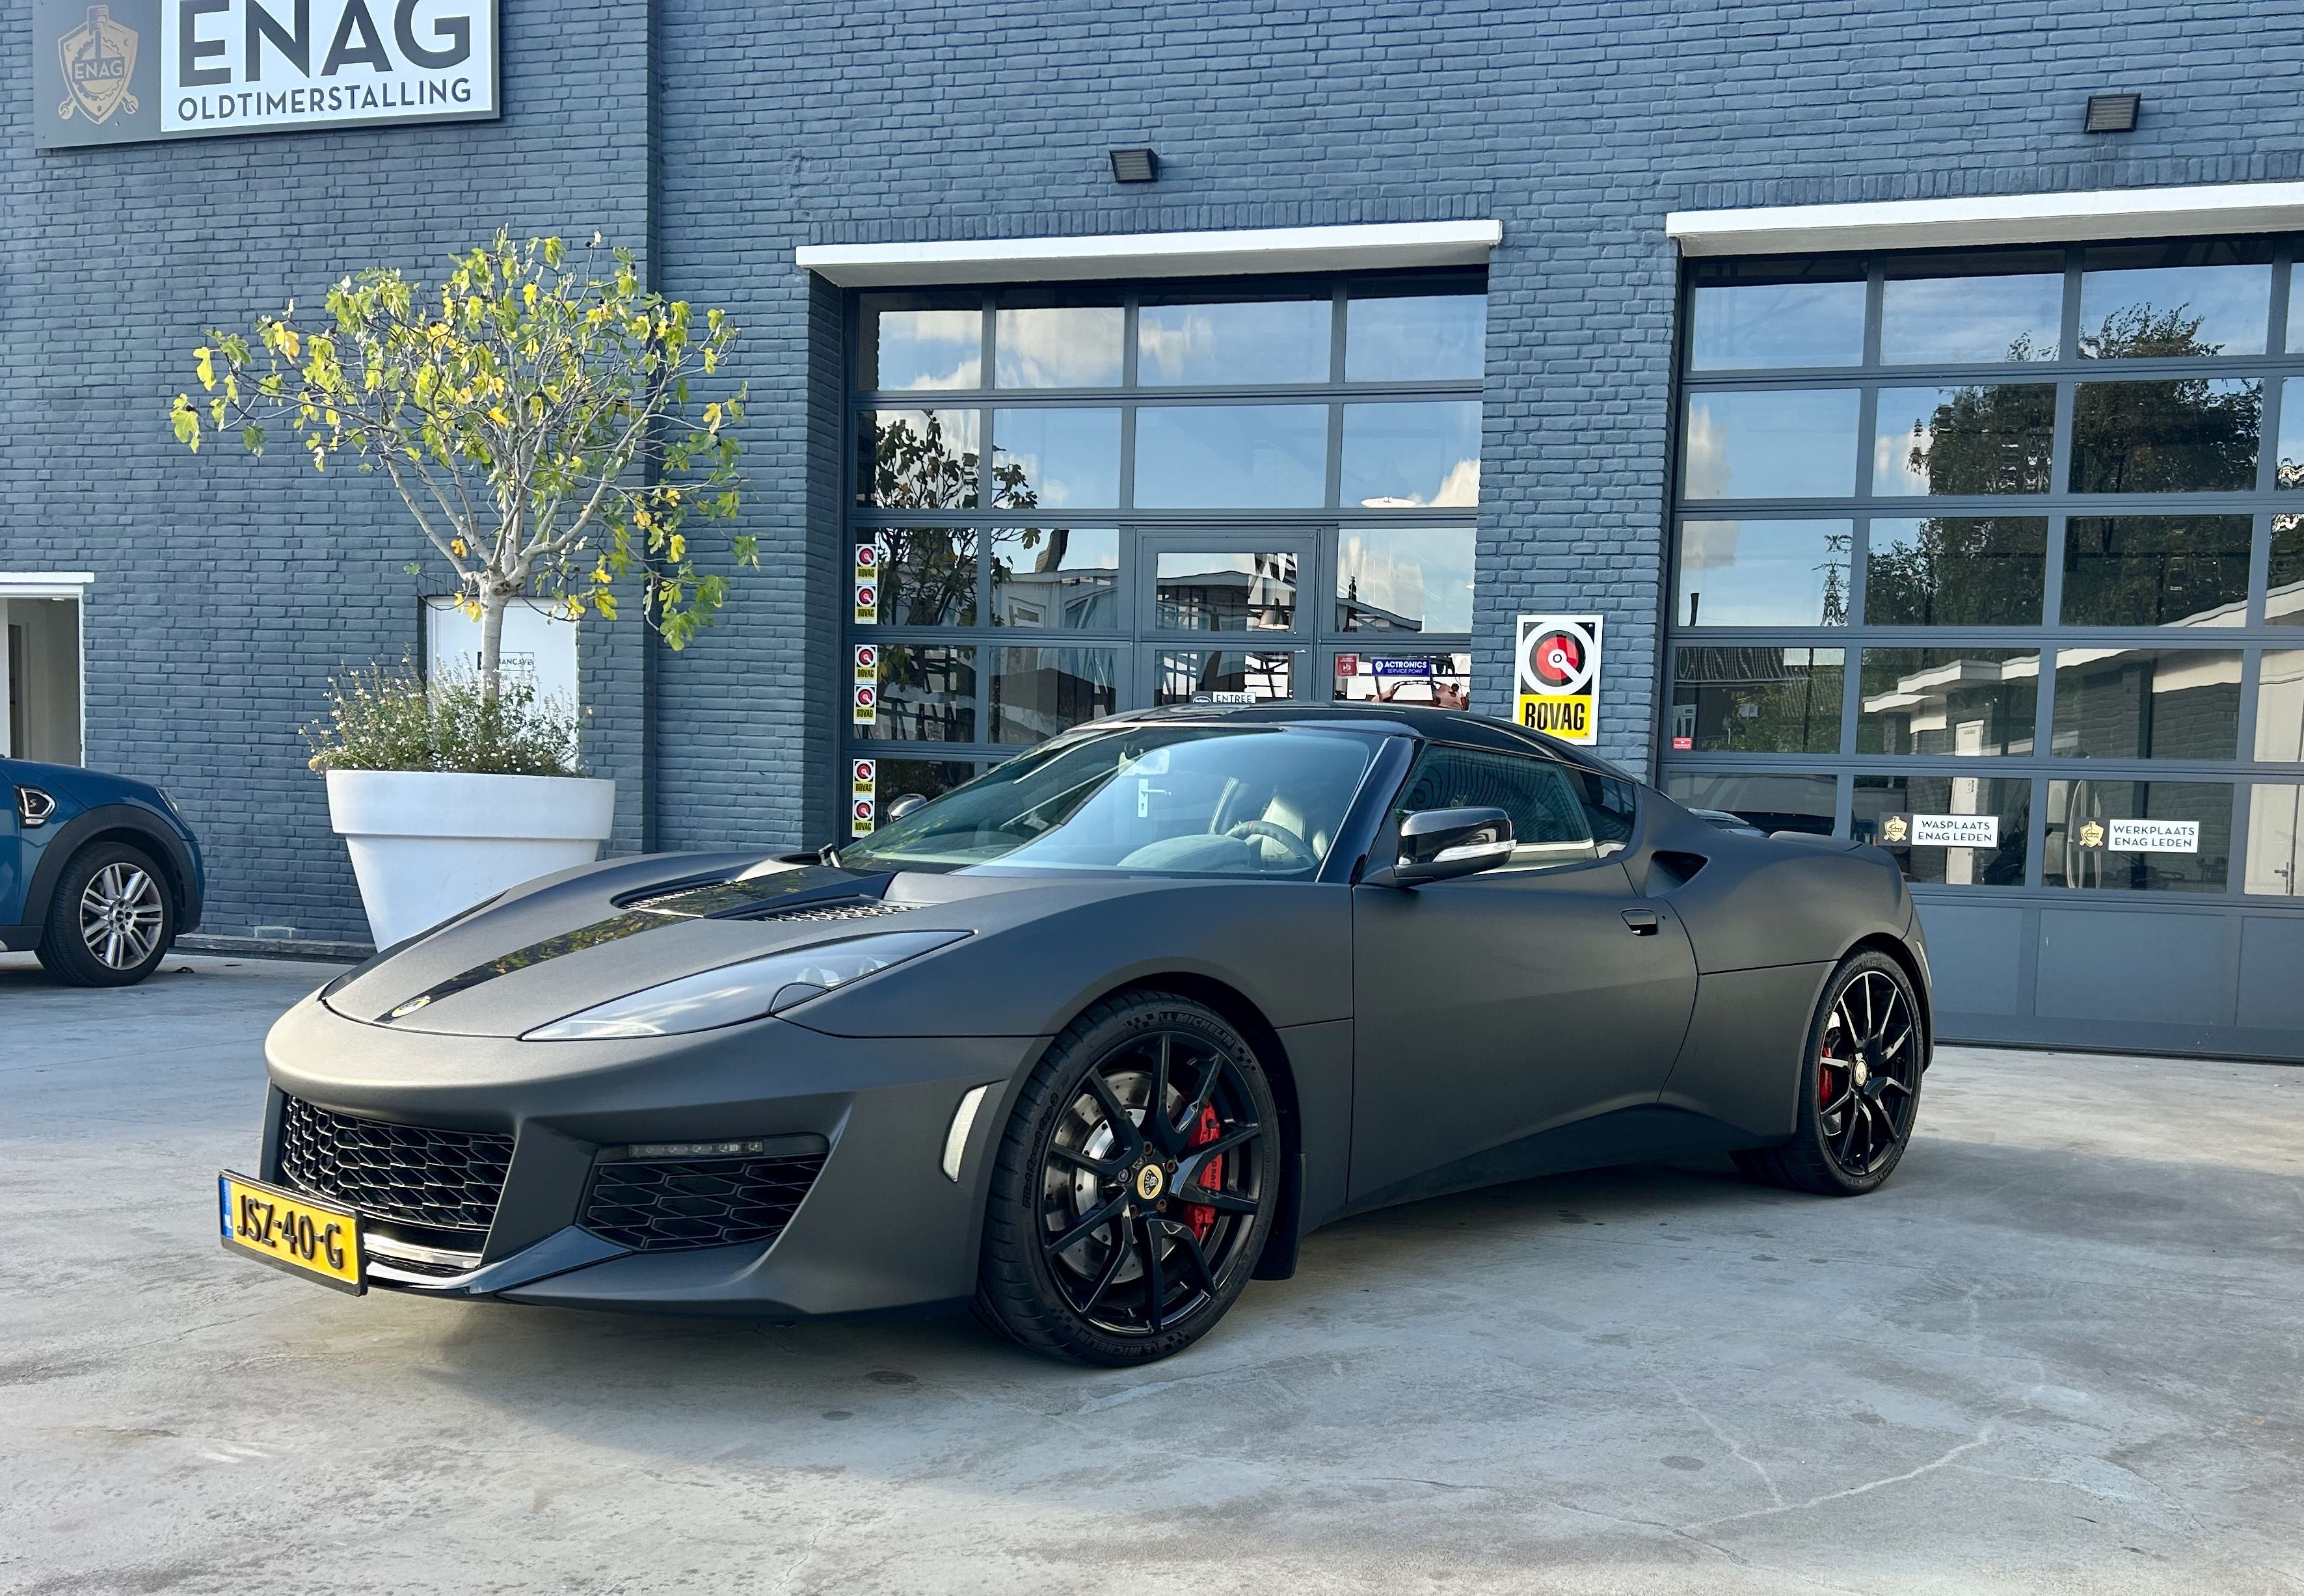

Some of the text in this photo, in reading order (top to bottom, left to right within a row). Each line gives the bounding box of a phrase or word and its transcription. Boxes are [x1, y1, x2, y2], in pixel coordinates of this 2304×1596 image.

[179, 0, 470, 87] ENAG
[75, 60, 123, 80] ENAG
[178, 77, 471, 121] OLDTIMERSTALLING
[1216, 695, 1252, 704] ENTREE
[1525, 702, 1585, 730] BOVAG
[1922, 820, 1990, 830] WASPLAATS
[2113, 825, 2195, 836] WERKPLAATS
[1918, 831, 1992, 842] ENAG LEDEN
[2115, 837, 2192, 847] ENAG LEDEN
[1175, 1013, 1237, 1046] MICHELIN
[237, 1195, 343, 1269] JSZ-40-G
